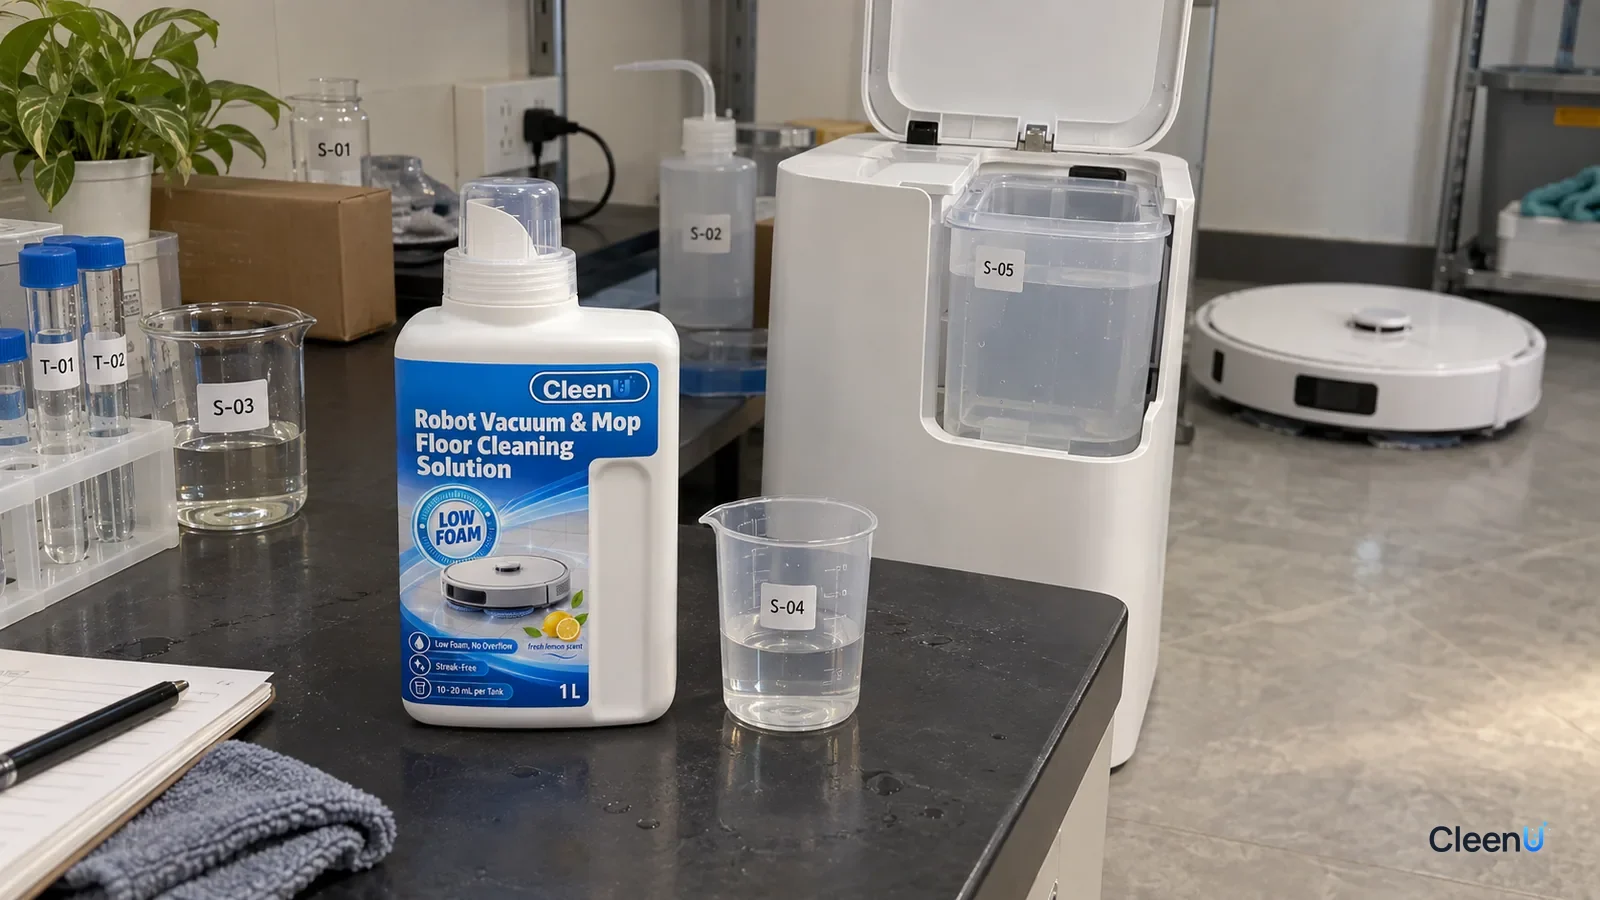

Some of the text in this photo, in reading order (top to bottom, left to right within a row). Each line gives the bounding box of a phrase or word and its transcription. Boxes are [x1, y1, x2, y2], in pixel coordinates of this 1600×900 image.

[317, 142, 351, 158] S-01
[690, 226, 722, 241] S-02
[983, 260, 1014, 278] S-05
[39, 356, 74, 375] T-01
[92, 352, 125, 371] T-02
[213, 398, 254, 416] S-03
[415, 408, 641, 436] Robot Vacuum & Mop
[416, 433, 574, 460] Floor Cleaning
[416, 455, 511, 479] Solution
[439, 509, 475, 528] LOW
[435, 526, 481, 546] FOAM
[770, 599, 804, 615] S-04
[435, 640, 448, 648] Low
[449, 640, 470, 650] Foam,
[471, 640, 482, 649] No
[435, 662, 477, 671] Streak-Free
[461, 687, 473, 695] mL
[474, 688, 486, 697] per
[487, 687, 504, 696] Tank
